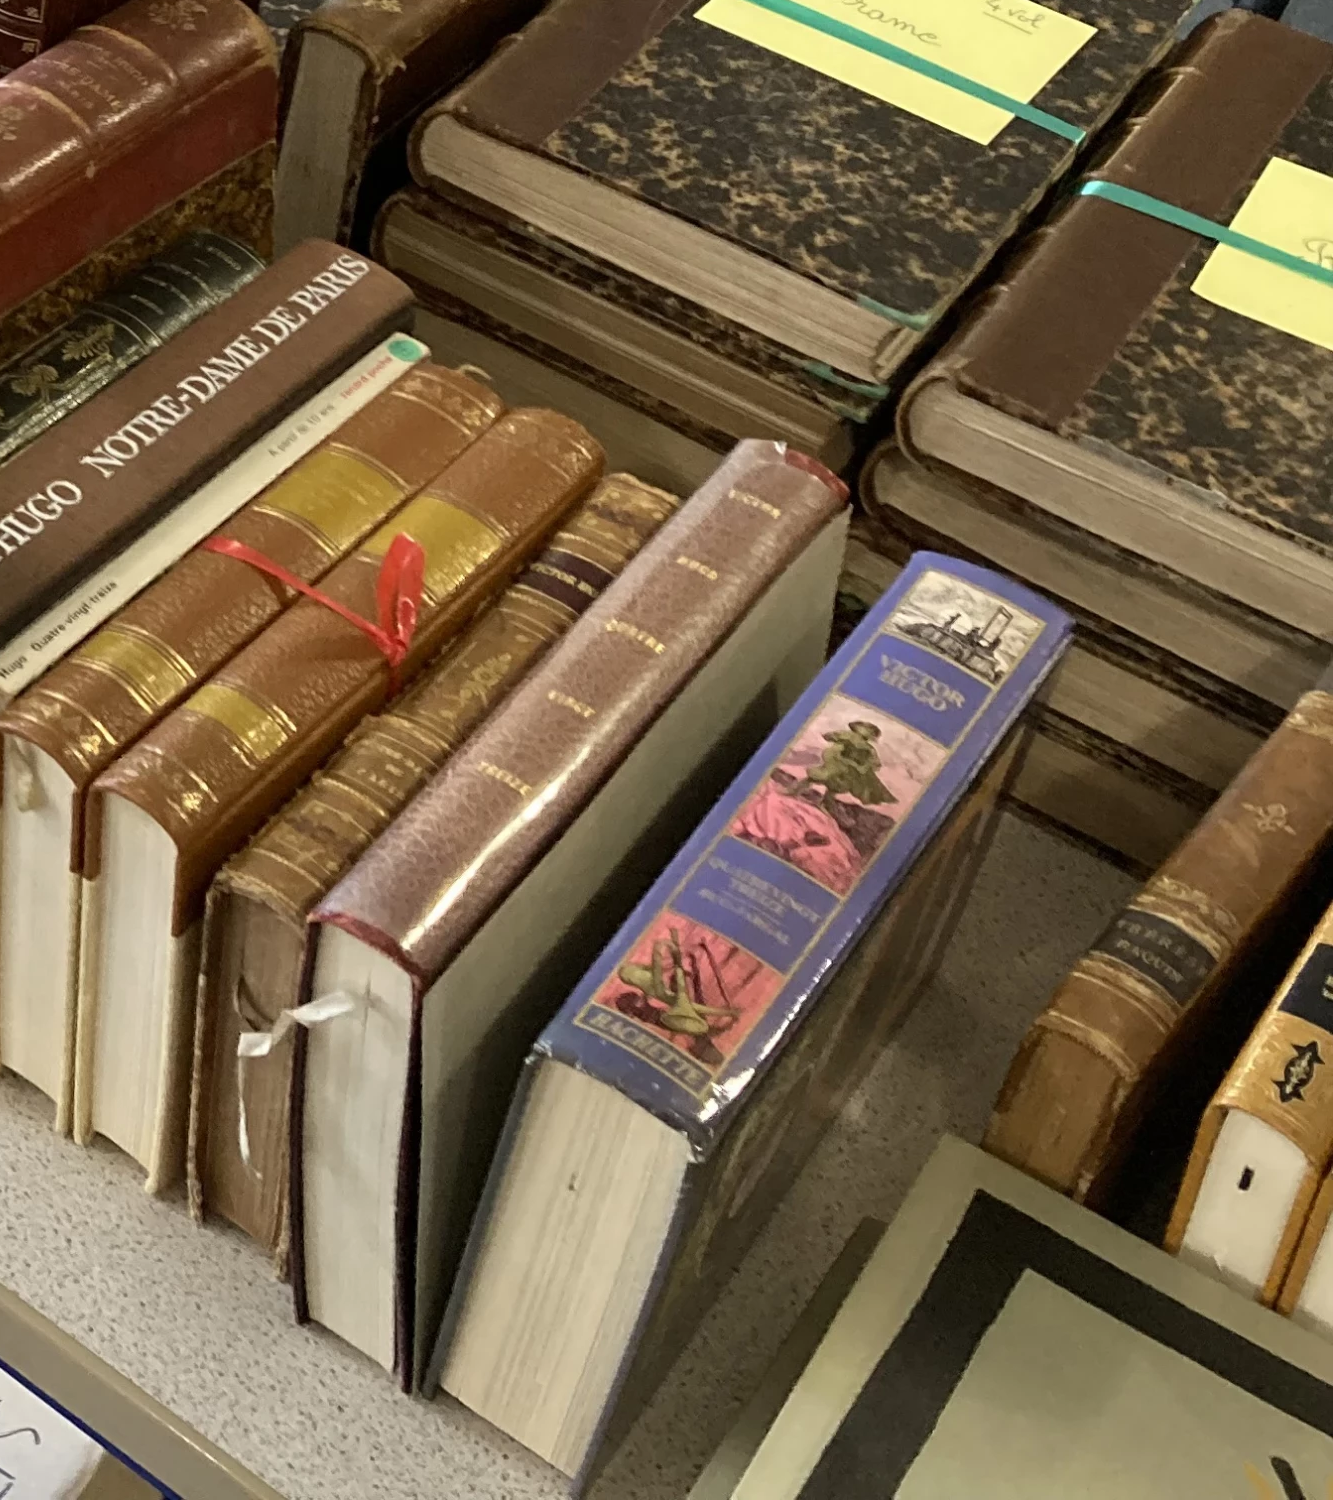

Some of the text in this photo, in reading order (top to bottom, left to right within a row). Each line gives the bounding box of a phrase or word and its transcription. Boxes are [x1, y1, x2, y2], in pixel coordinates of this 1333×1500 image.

[1007, 6, 1048, 31] vol
[79, 330, 270, 480] NOTRE-DAME
[251, 301, 308, 347] DE
[298, 252, 372, 318] PARIS
[878, 669, 949, 713] HUGO
[879, 652, 968, 710] VICTOR
[1115, 938, 1185, 985] RAQUIN
[590, 1006, 709, 1087] HACHETTE
